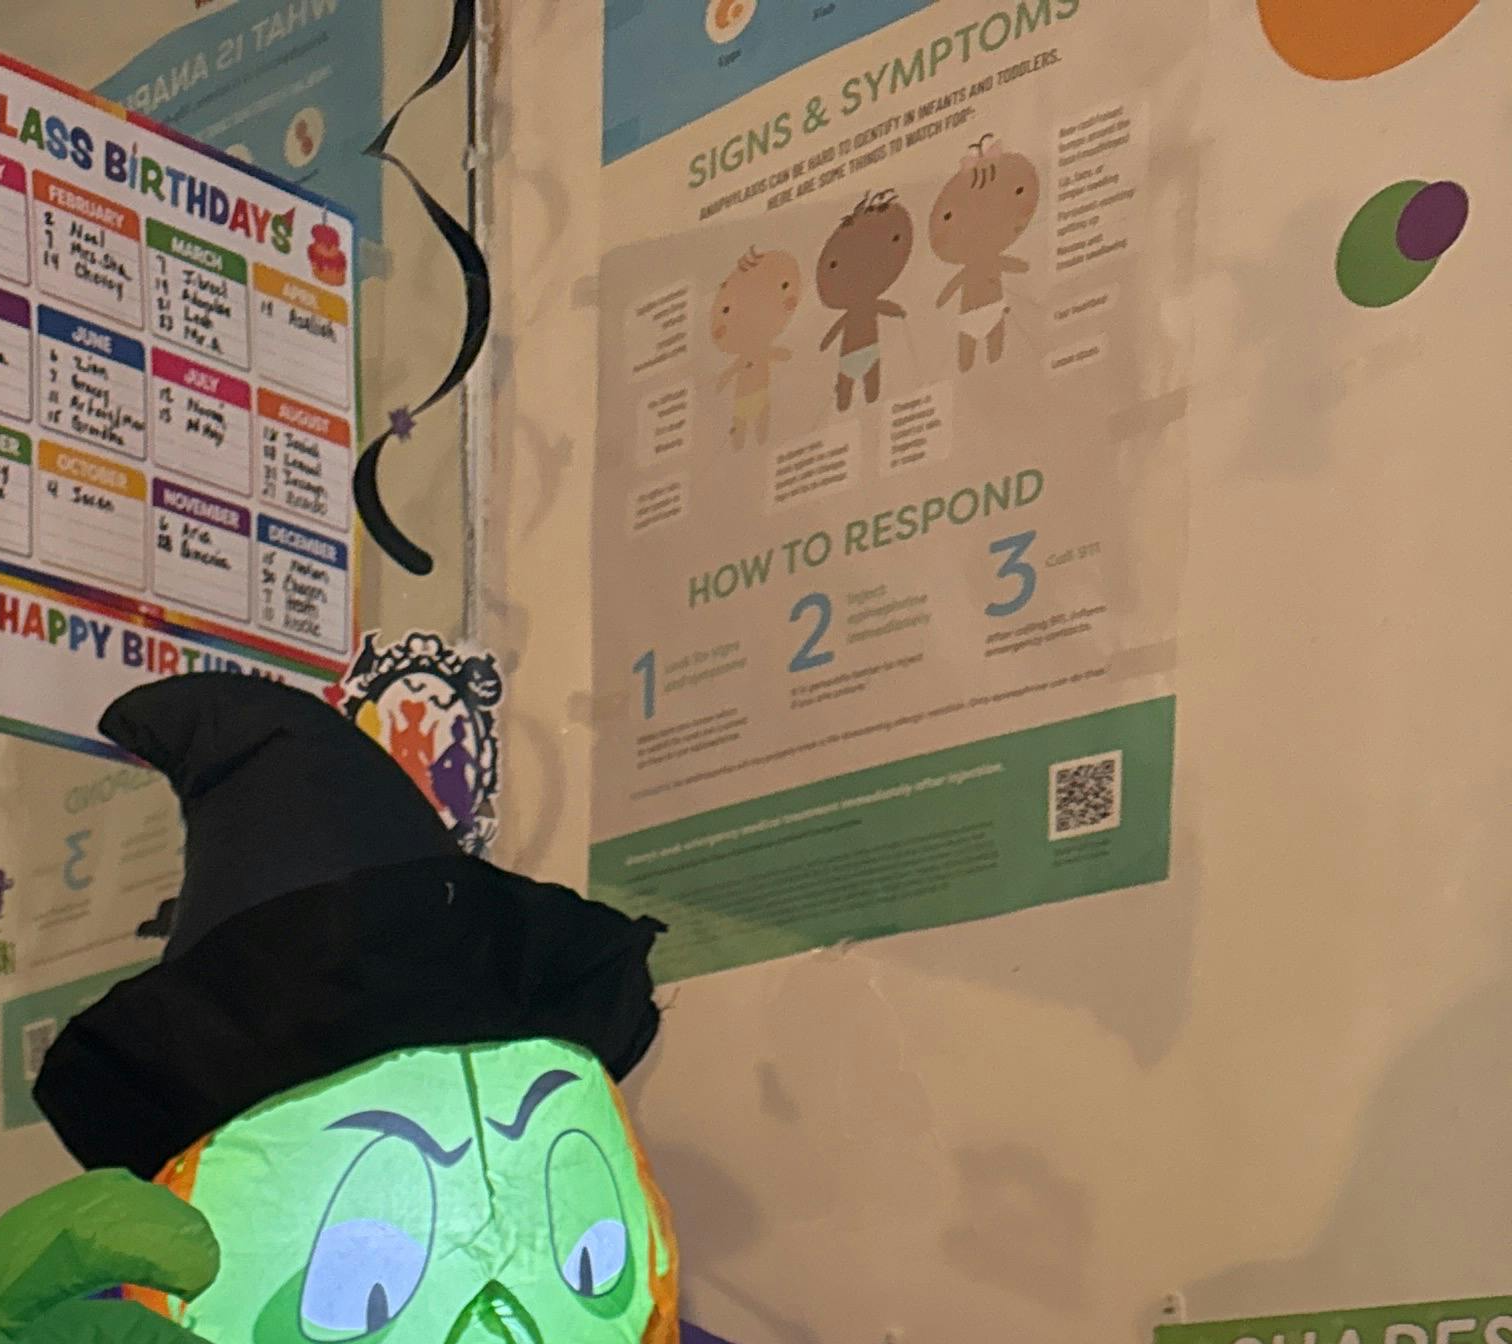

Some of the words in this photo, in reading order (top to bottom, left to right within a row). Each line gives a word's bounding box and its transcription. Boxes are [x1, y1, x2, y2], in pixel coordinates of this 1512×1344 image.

[968, 75, 993, 98] AND
[688, 112, 792, 188] SIGNS
[803, 95, 831, 134] &
[49, 185, 125, 228] FEBRUARY
[105, 138, 295, 254] BIRTHDAYS
[171, 236, 224, 271] MARCH
[71, 325, 113, 354] JUNE
[56, 453, 128, 488] OCTOBER
[162, 488, 240, 528] NOVEMBER
[268, 523, 338, 562] DECEMBER
[688, 549, 774, 608] HOW
[782, 530, 831, 575] TO
[845, 469, 1044, 555] RESPOND
[984, 529, 1037, 617] 3
[788, 592, 835, 673] 2
[632, 649, 656, 720] 1
